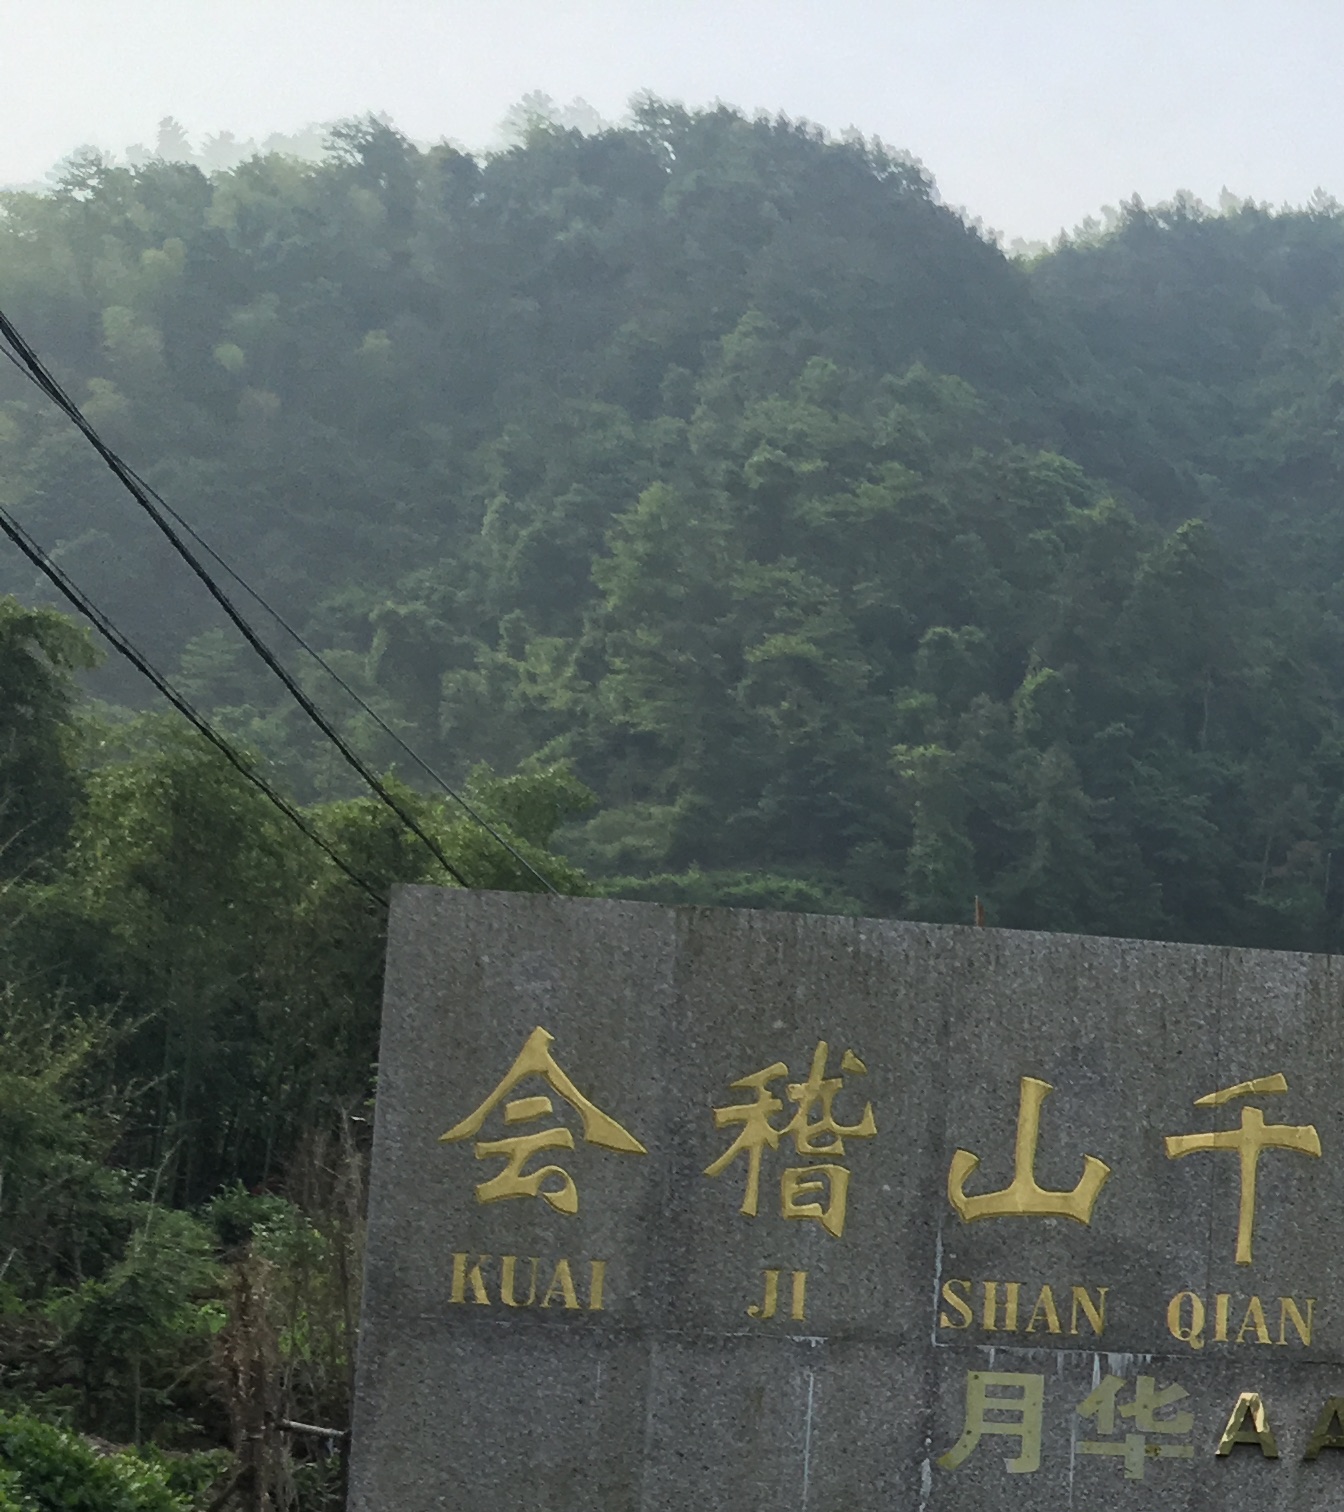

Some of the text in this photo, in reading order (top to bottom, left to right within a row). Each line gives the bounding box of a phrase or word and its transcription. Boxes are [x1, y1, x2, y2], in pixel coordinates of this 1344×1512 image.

[449, 1251, 604, 1313] KUAI
[747, 1268, 809, 1321] JI
[940, 1279, 1110, 1336] SHAN
[1166, 1290, 1316, 1350] QIAN
